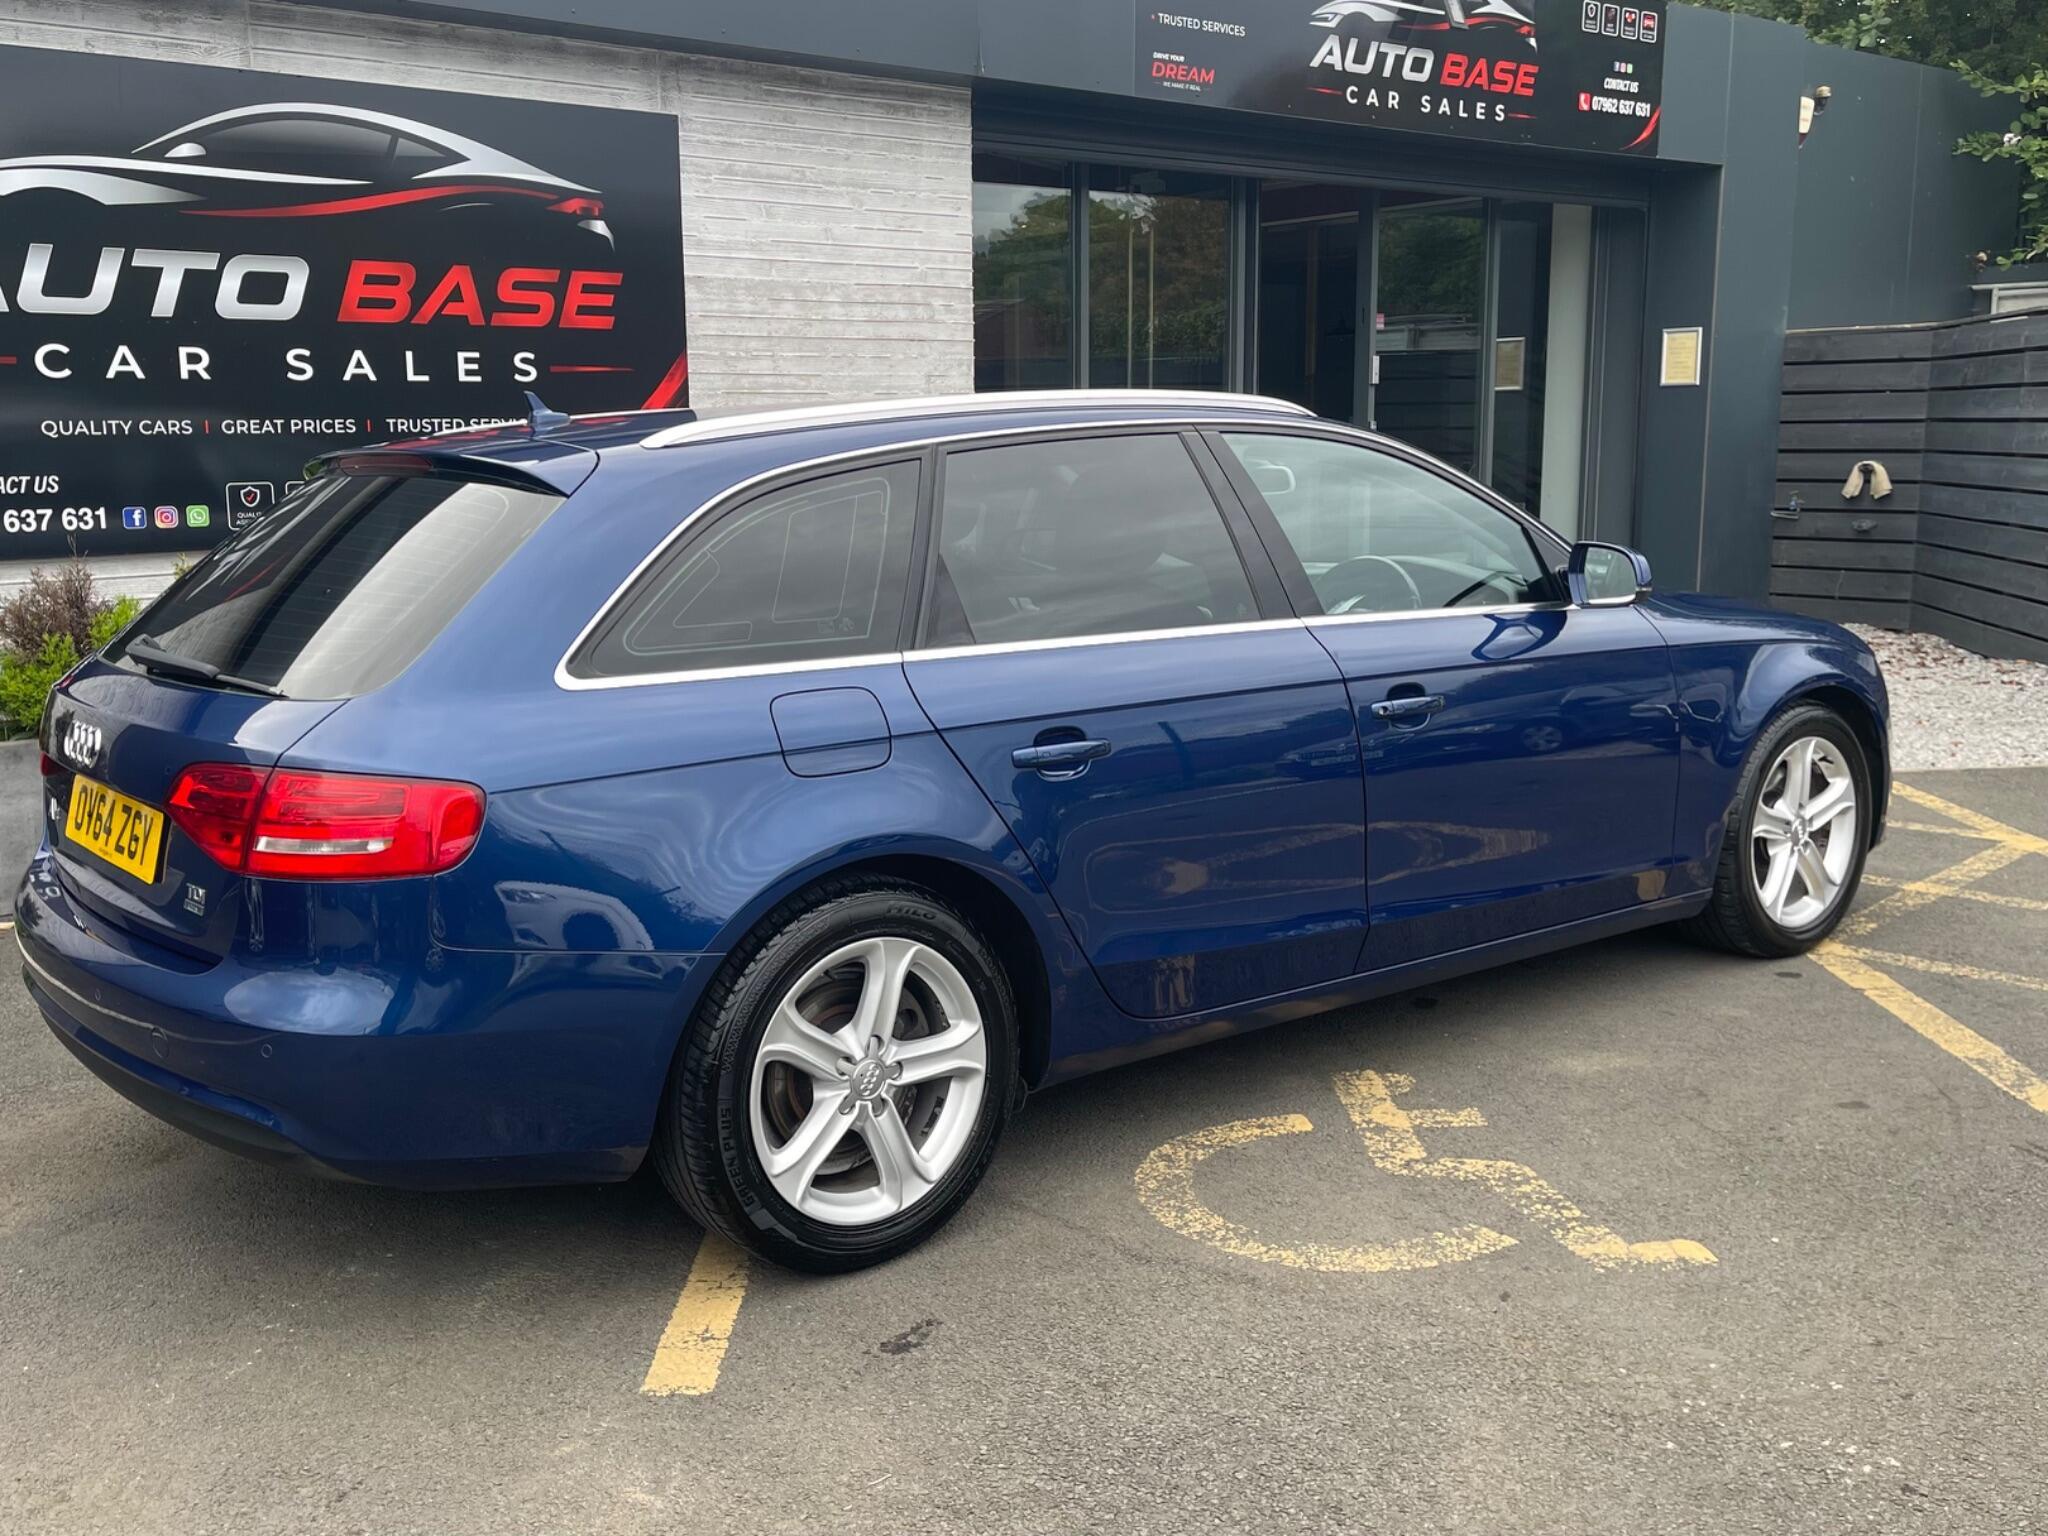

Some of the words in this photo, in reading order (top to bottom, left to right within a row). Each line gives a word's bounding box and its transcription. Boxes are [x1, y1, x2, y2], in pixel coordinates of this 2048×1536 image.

[1158, 13, 1200, 29] TRUSTED
[1202, 20, 1246, 37] SERVICES
[1152, 61, 1215, 84] DREAM
[1309, 34, 1435, 83] AUTO
[1440, 53, 1539, 97] BASE
[1604, 77, 1630, 91] CONTACT
[1630, 81, 1640, 93] US
[1346, 85, 1400, 110] CAR
[1420, 95, 1506, 121] SALES
[1592, 95, 1618, 113] 07962
[1619, 99, 1635, 115] 637
[1635, 102, 1651, 117] 631
[0, 243, 310, 321] UTO
[337, 260, 624, 330] BASE
[34, 343, 212, 380] CAR
[286, 348, 538, 382] SALES
[40, 420, 132, 438] QUALITY
[138, 419, 193, 435] CARS
[221, 419, 285, 434] GREAT
[290, 418, 357, 434] PRICES
[386, 418, 465, 433] TRUSTED
[33, 475, 59, 494] US
[3, 508, 53, 533] 637
[61, 506, 107, 531] 631
[114, 803, 154, 866] ZGY
